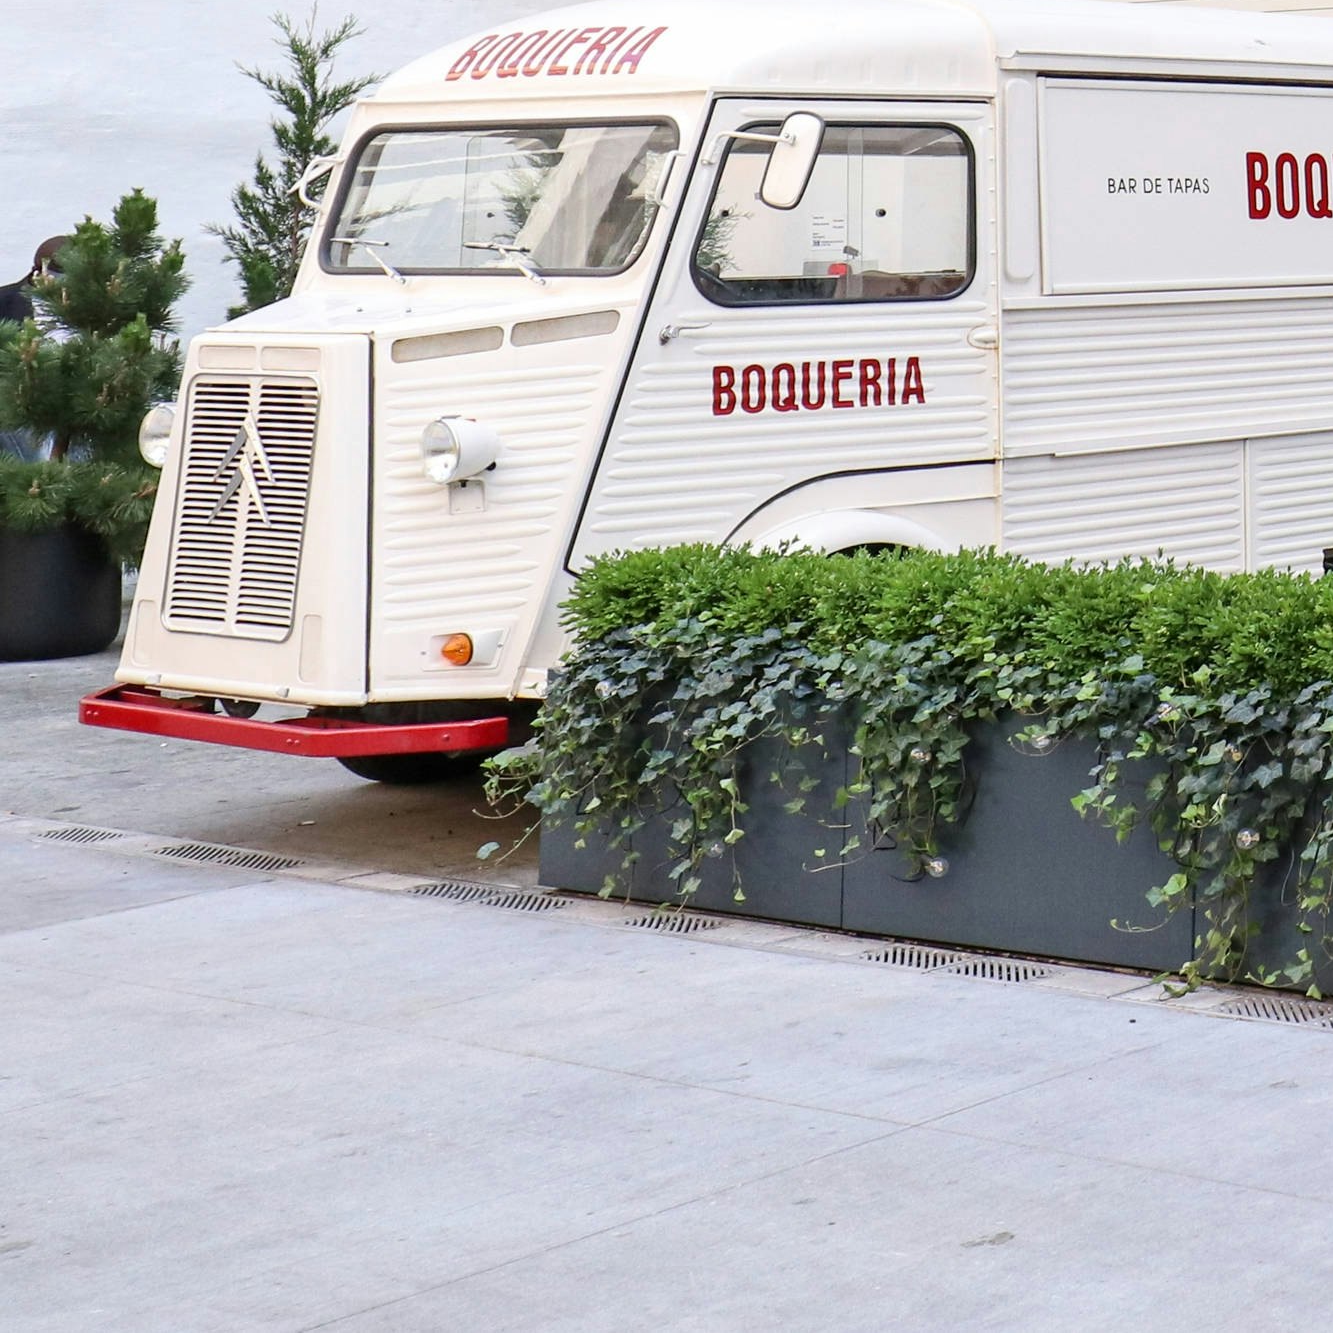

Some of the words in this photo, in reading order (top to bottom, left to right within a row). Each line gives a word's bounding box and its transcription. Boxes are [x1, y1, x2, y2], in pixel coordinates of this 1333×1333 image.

[444, 25, 669, 82] BOQUERIA
[1107, 177, 1137, 195] BAR
[1143, 177, 1162, 194] DE
[1167, 177, 1210, 195] TAPAS
[711, 356, 926, 416] BOQUERIA
